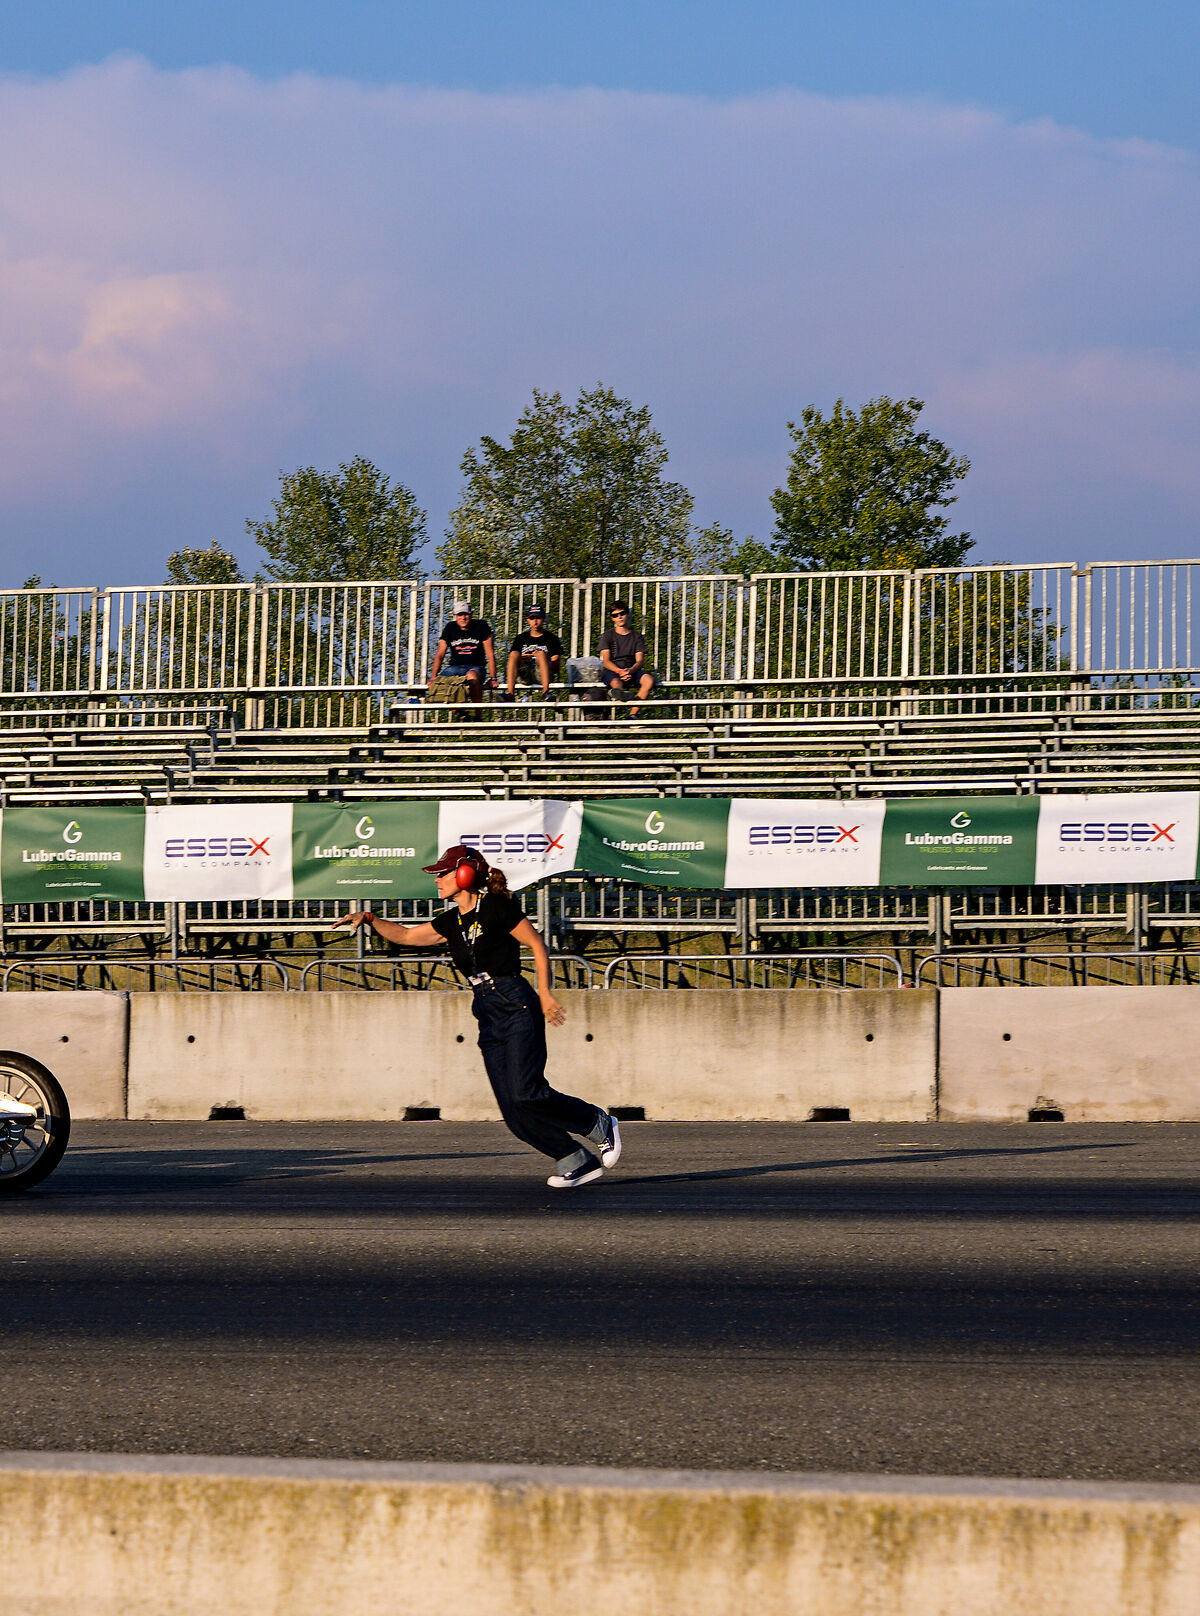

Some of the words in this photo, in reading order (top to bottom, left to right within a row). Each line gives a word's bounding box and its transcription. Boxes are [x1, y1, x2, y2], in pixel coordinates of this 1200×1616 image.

[749, 825, 861, 845] ESSEX
[904, 832, 1013, 845] LubroGamma
[1060, 822, 1176, 842] ESSEX
[165, 837, 271, 858] ESSEX
[460, 833, 565, 854] ESSEX
[602, 837, 705, 852] LubroGamma
[785, 847, 860, 855] COMPANY
[22, 849, 122, 863] LubroGamma
[314, 844, 416, 859] LubroGamma
[200, 860, 271, 868] COMPANY
